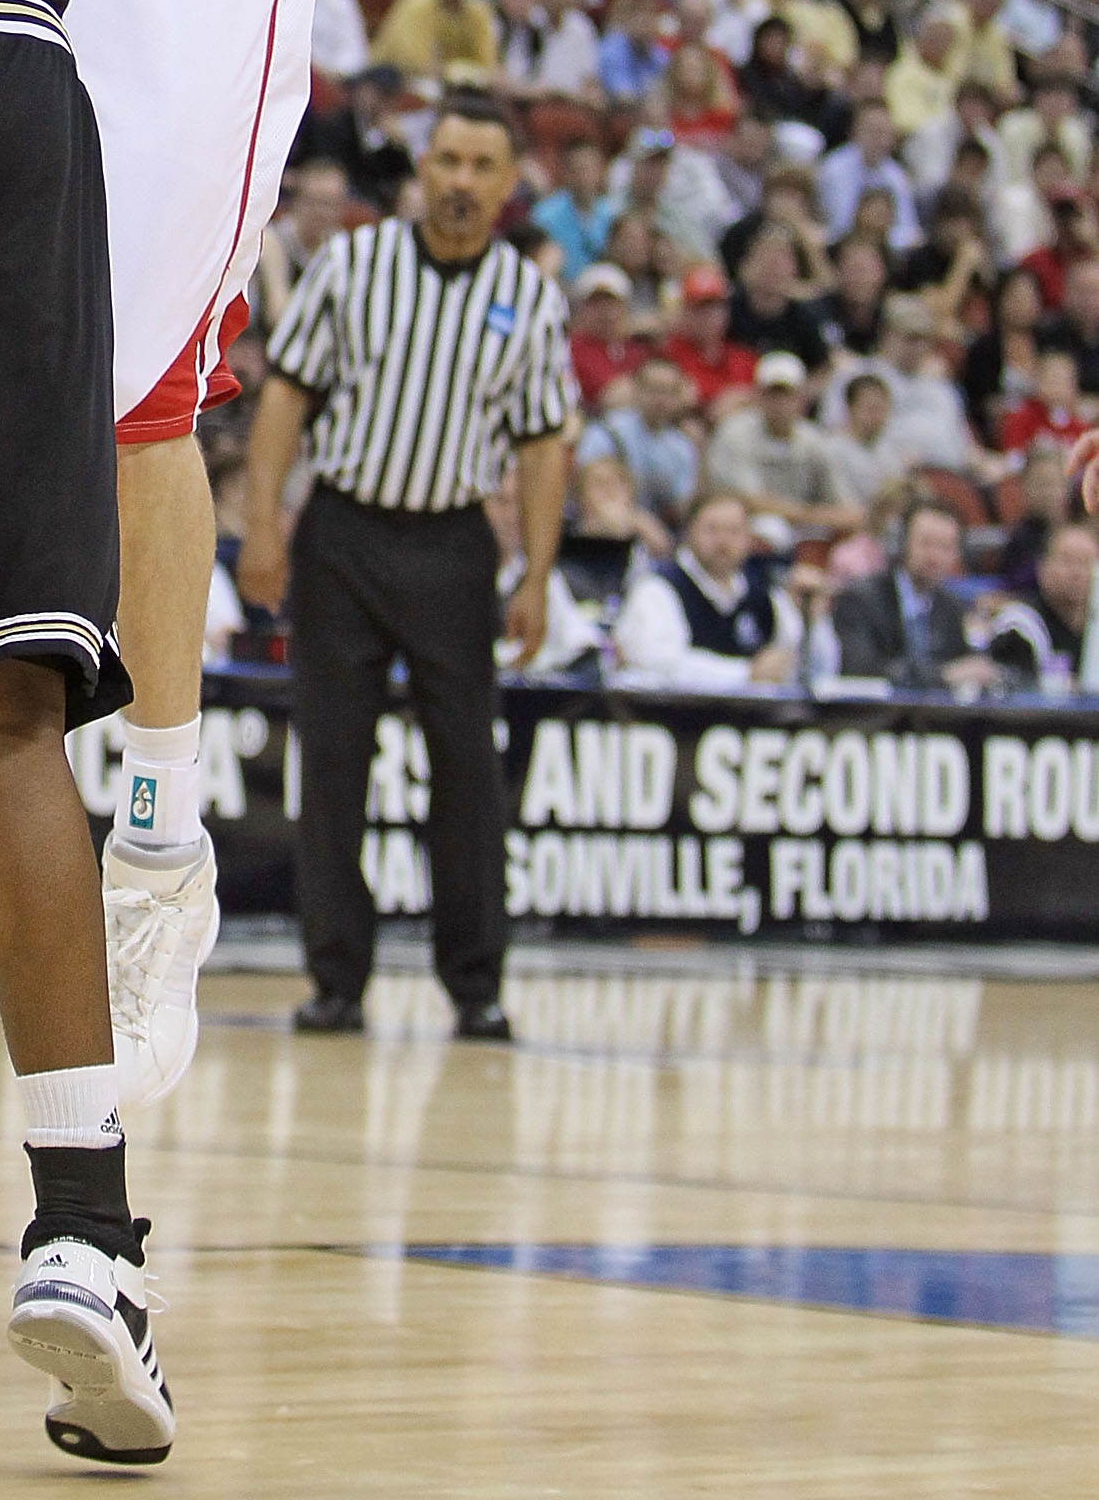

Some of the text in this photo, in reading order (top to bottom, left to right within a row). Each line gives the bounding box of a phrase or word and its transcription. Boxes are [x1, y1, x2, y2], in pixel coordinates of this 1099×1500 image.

[520, 717, 678, 830] AND
[689, 722, 971, 837] SECOND
[769, 836, 990, 922] FLORIDA
